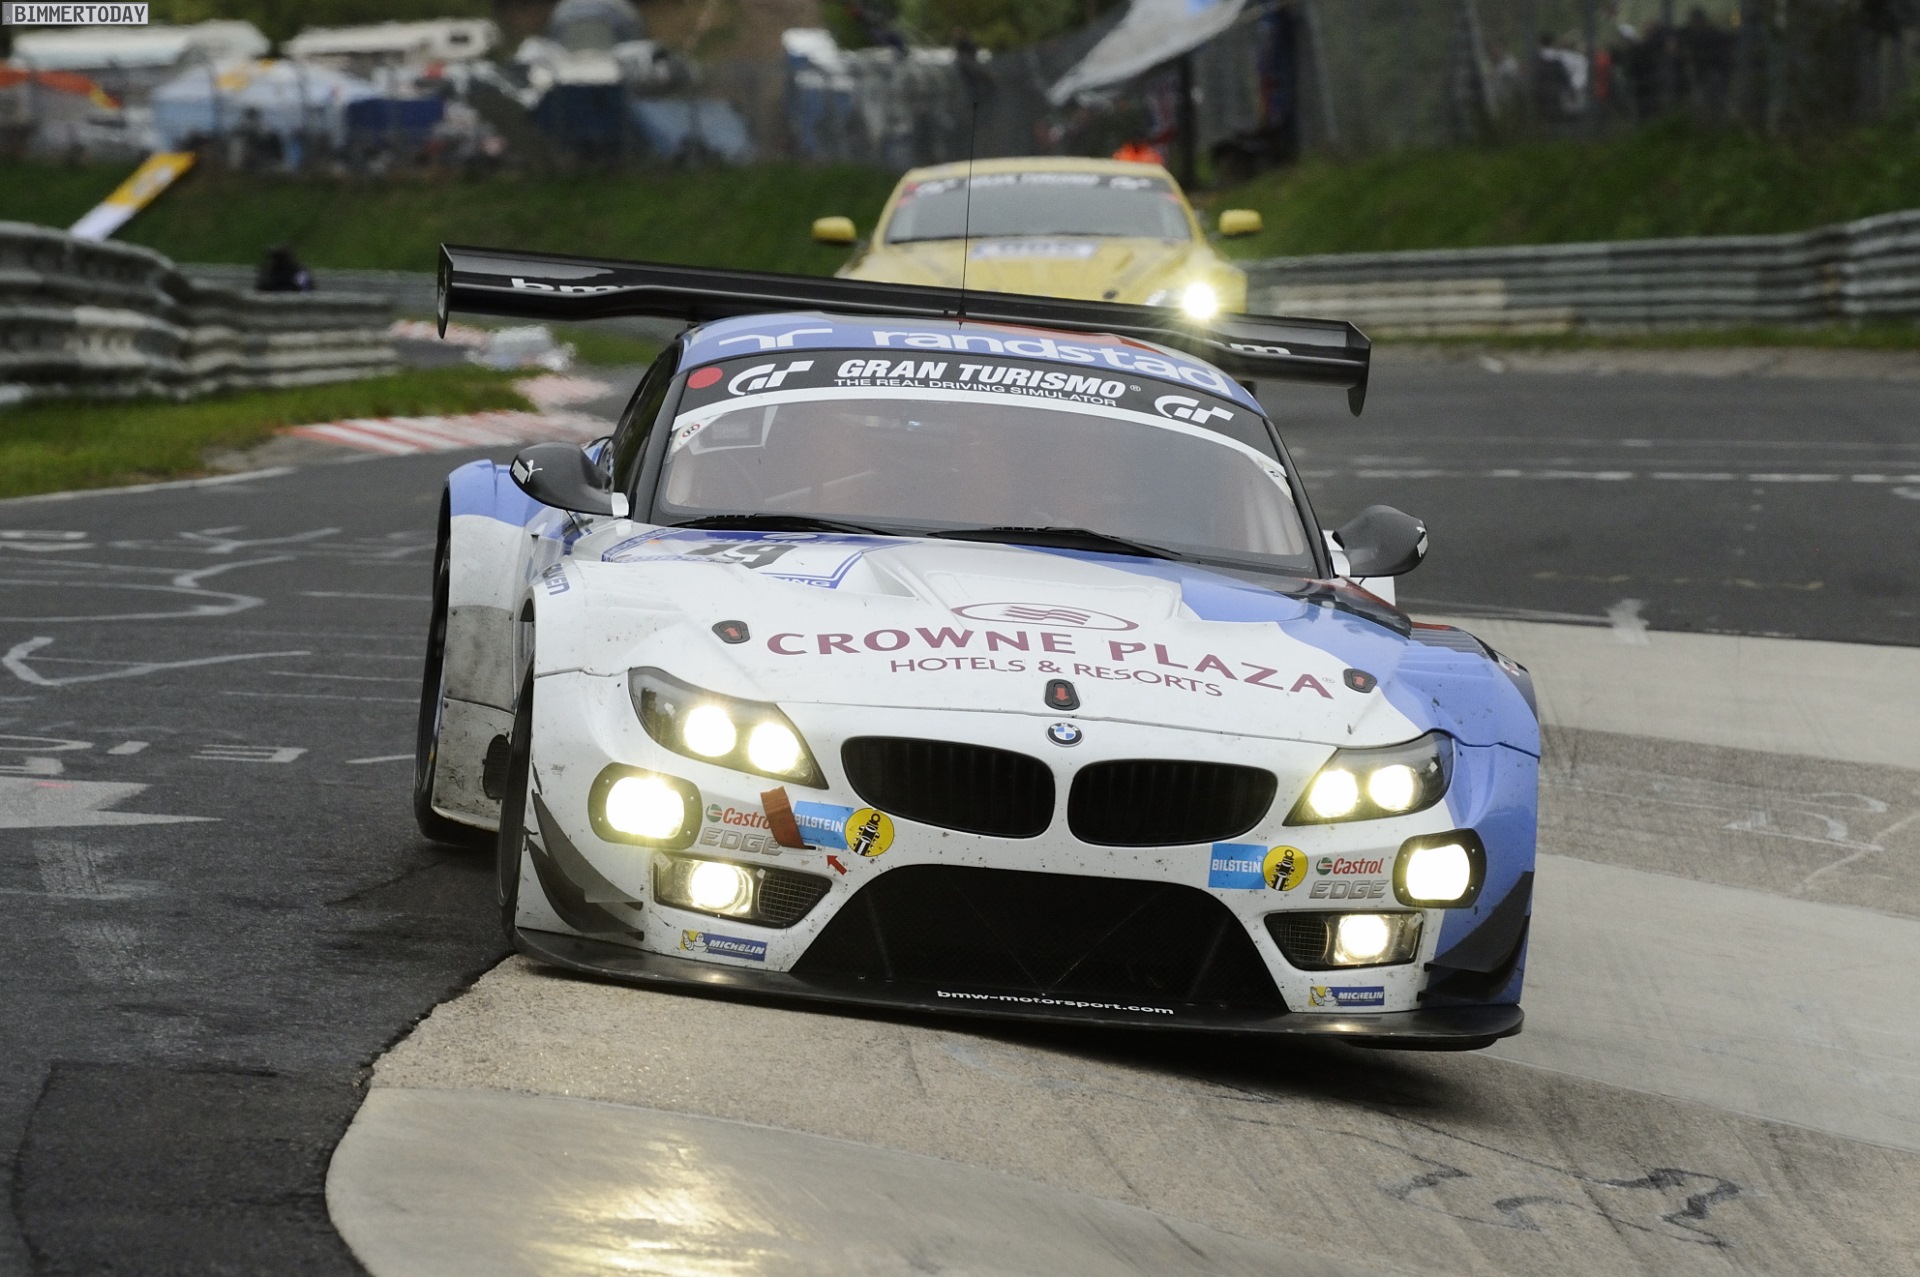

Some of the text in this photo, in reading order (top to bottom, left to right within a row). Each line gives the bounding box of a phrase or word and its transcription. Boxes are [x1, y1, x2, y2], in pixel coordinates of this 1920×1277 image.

[837, 359, 948, 380] GRAN
[872, 330, 1233, 397] randstad
[834, 378, 1118, 407] THE REAL DRIVING SIMULATOR
[767, 627, 1334, 699] CROWNE PLAZA
[891, 657, 1223, 697] HOTELS & RESORTS
[723, 807, 771, 830] Castro
[699, 826, 782, 857] EDGE
[1212, 858, 1261, 873] BILSTEIN
[1333, 857, 1384, 875] Castrol
[1309, 879, 1390, 900] EDGE
[708, 940, 765, 955] MICHELIN
[936, 990, 1175, 1015] bmw-motorsport.com
[1338, 991, 1384, 1000] MICHELIN
